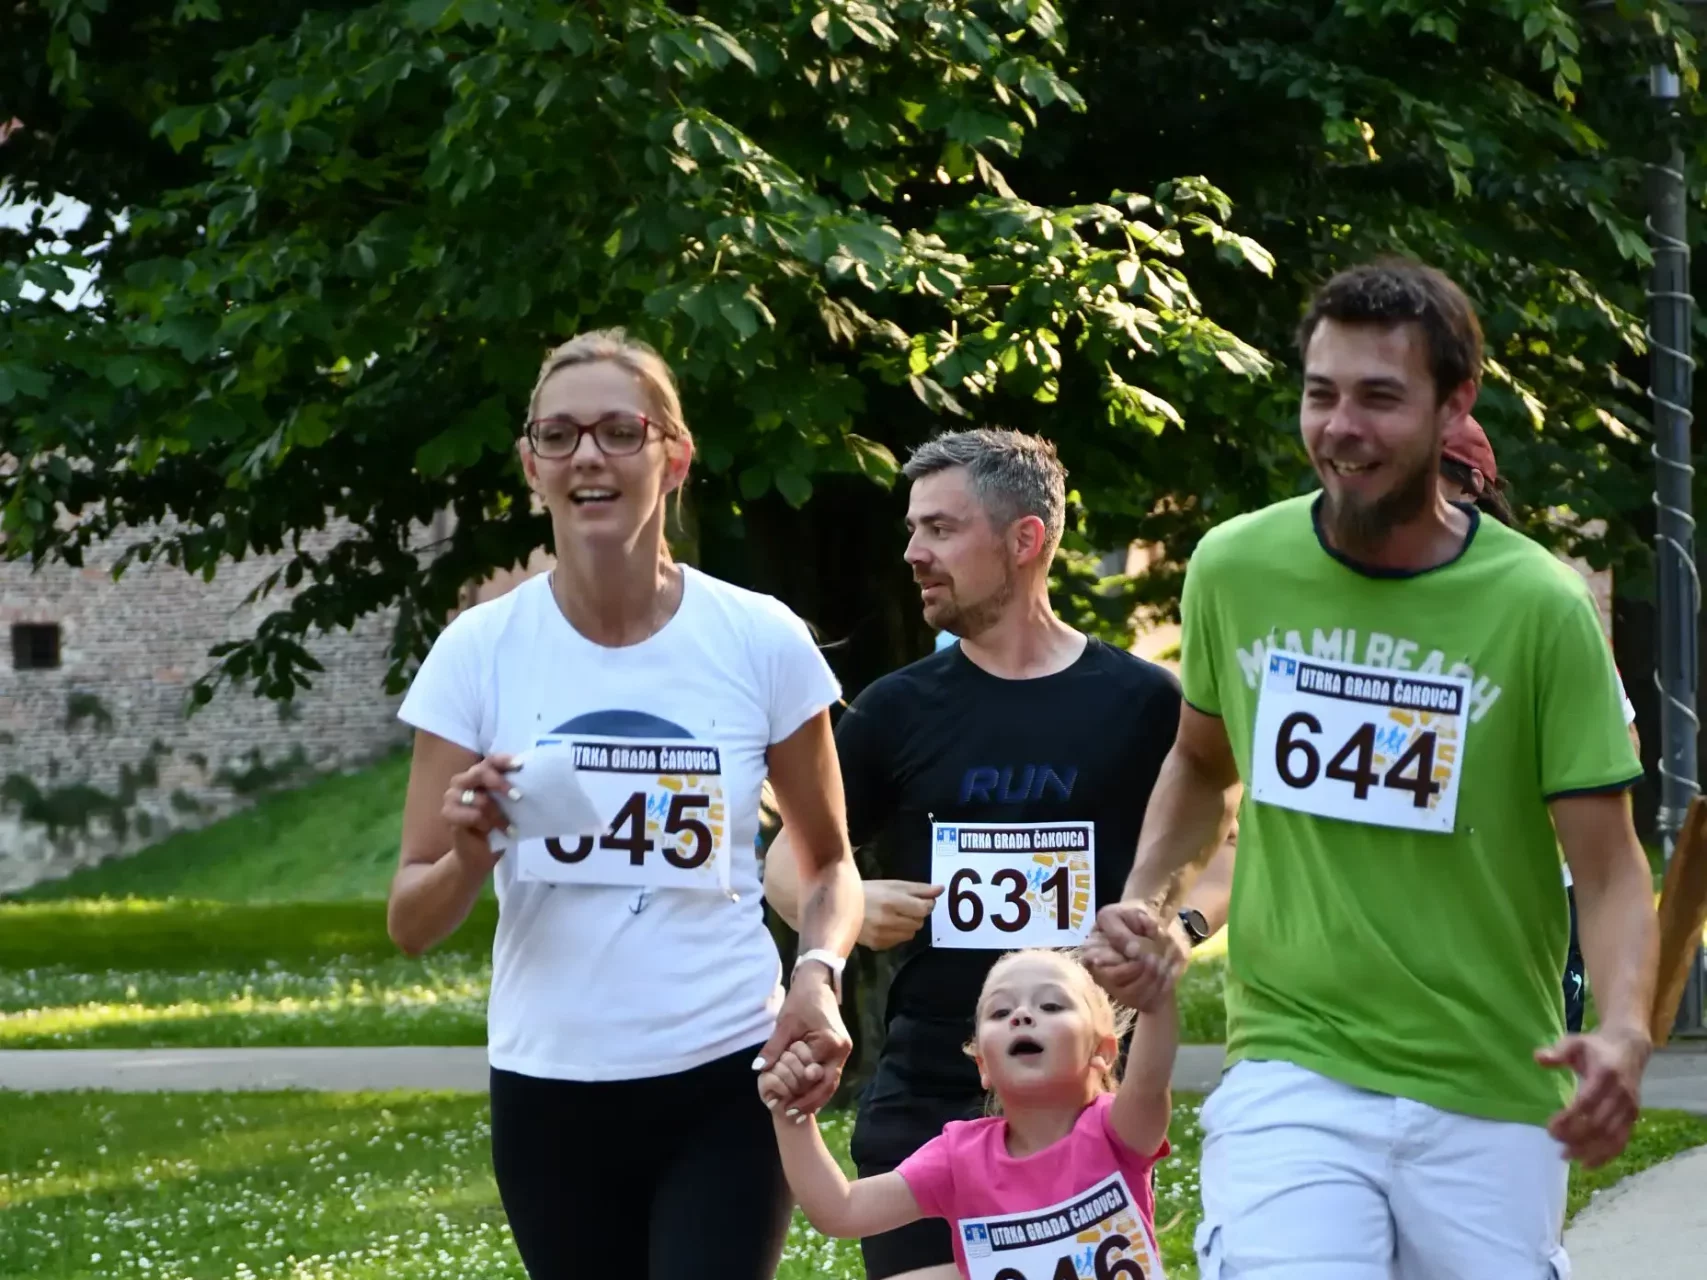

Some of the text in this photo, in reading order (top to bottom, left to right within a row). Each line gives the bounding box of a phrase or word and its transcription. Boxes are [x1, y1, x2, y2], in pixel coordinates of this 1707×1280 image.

[1300, 668, 1457, 710] UTRKA GRADA ČAKOVCA
[611, 747, 656, 770] GRADA
[660, 747, 717, 770] ČAKOVCA
[1275, 711, 1441, 808] 644
[959, 764, 1078, 803] RUN
[961, 829, 1085, 849] UTRKA GRADA ČAKOVCA
[947, 866, 1070, 933] 631
[990, 1187, 1123, 1247] UTRKA GRADA ČAKOVCA
